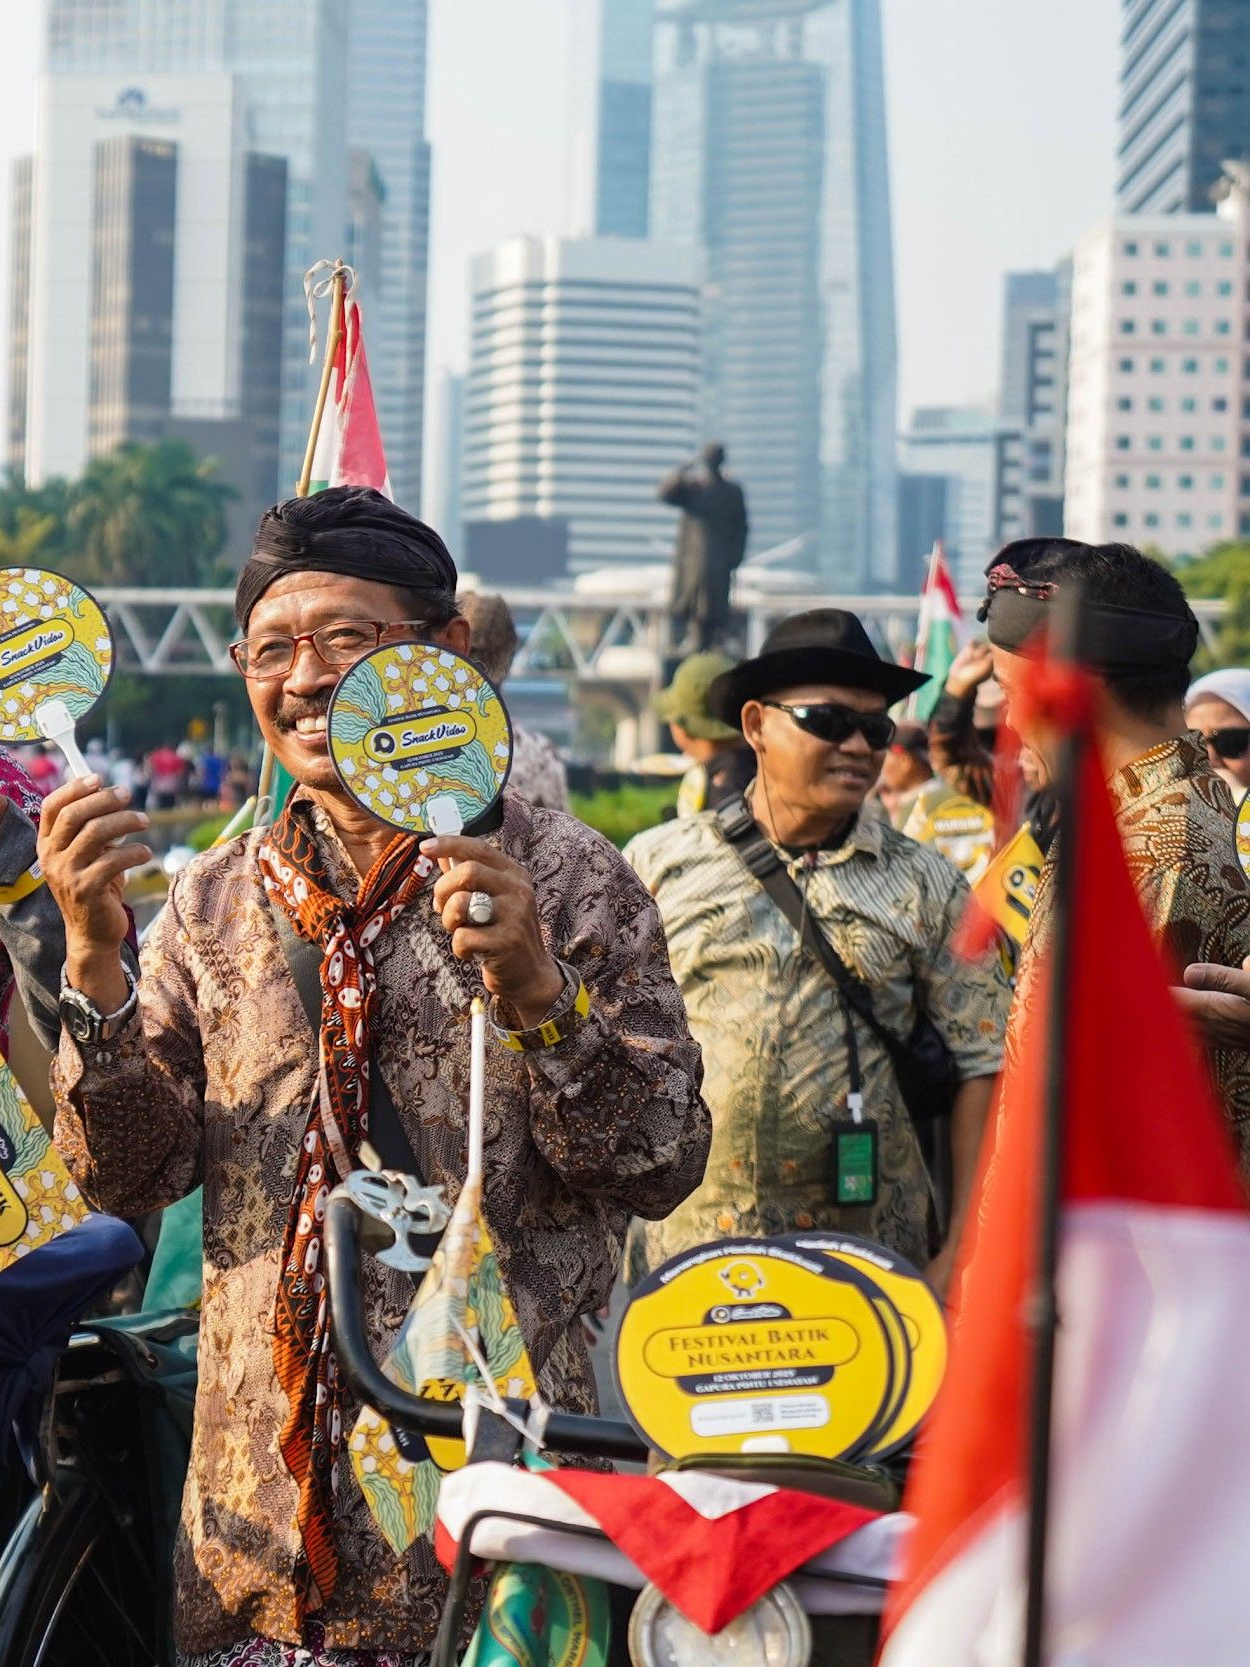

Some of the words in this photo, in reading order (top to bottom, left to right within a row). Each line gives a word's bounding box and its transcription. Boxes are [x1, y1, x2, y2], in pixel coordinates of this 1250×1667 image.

[669, 1333, 761, 1351] FESTIVAL
[768, 1328, 830, 1344] BATIK
[688, 1348, 816, 1368] NUSANTARA
